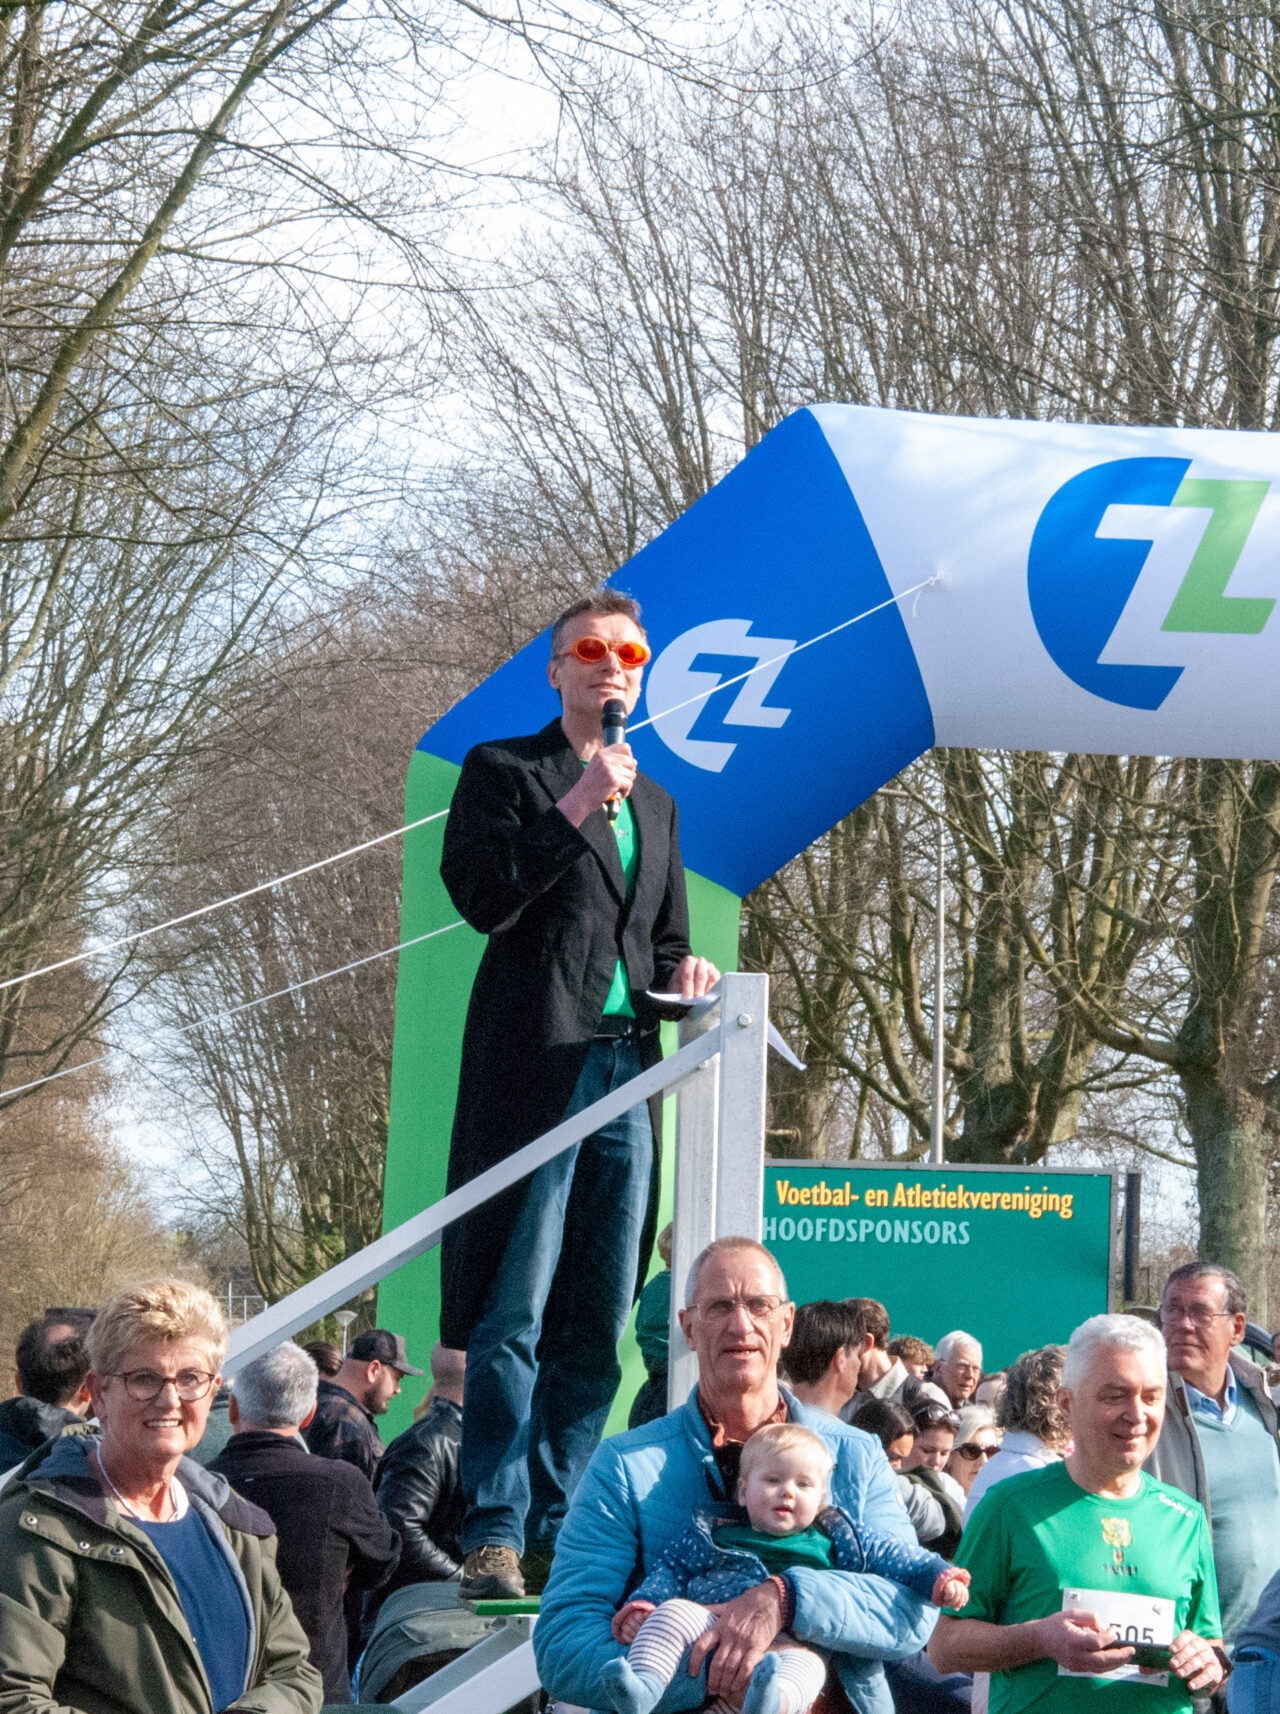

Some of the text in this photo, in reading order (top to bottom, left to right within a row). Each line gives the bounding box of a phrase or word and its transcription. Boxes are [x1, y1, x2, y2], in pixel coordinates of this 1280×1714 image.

[776, 1179, 1073, 1219] Voetbal- en Atletiekvereniging
[762, 1216, 970, 1245] HOOFDSPONSORS
